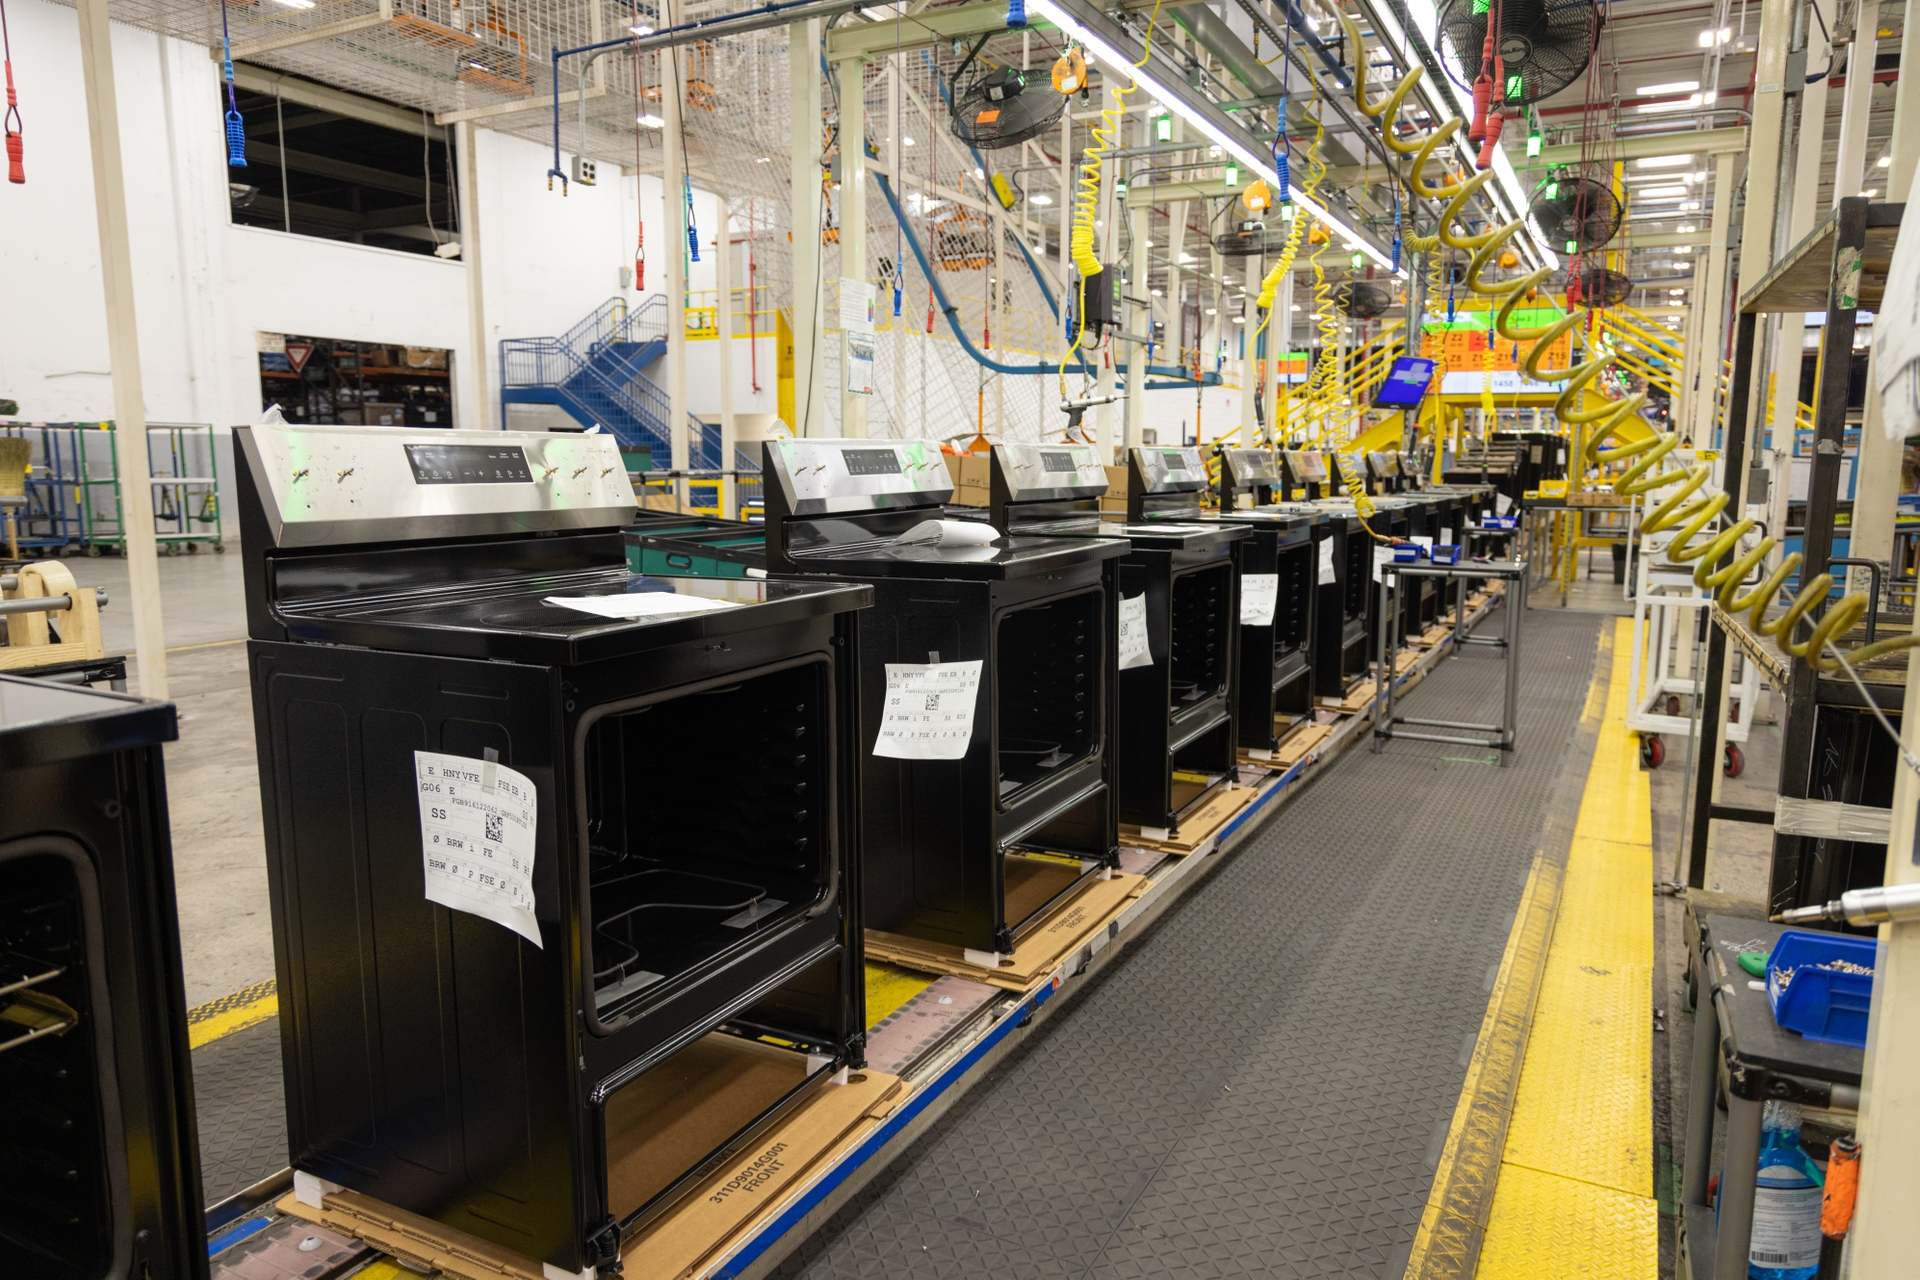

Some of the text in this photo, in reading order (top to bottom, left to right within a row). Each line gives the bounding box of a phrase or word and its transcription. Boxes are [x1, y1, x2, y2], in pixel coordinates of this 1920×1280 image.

[428, 766, 434, 775] E
[443, 769, 460, 779] HNY
[462, 771, 480, 782] VFE
[449, 786, 455, 795] E
[431, 807, 446, 820] SS
[447, 837, 463, 849] BRW
[429, 859, 446, 870] BRW
[480, 873, 494, 886] FSE
[709, 1142, 788, 1203] 311D9014G001
[742, 1160, 784, 1192] FRONT
